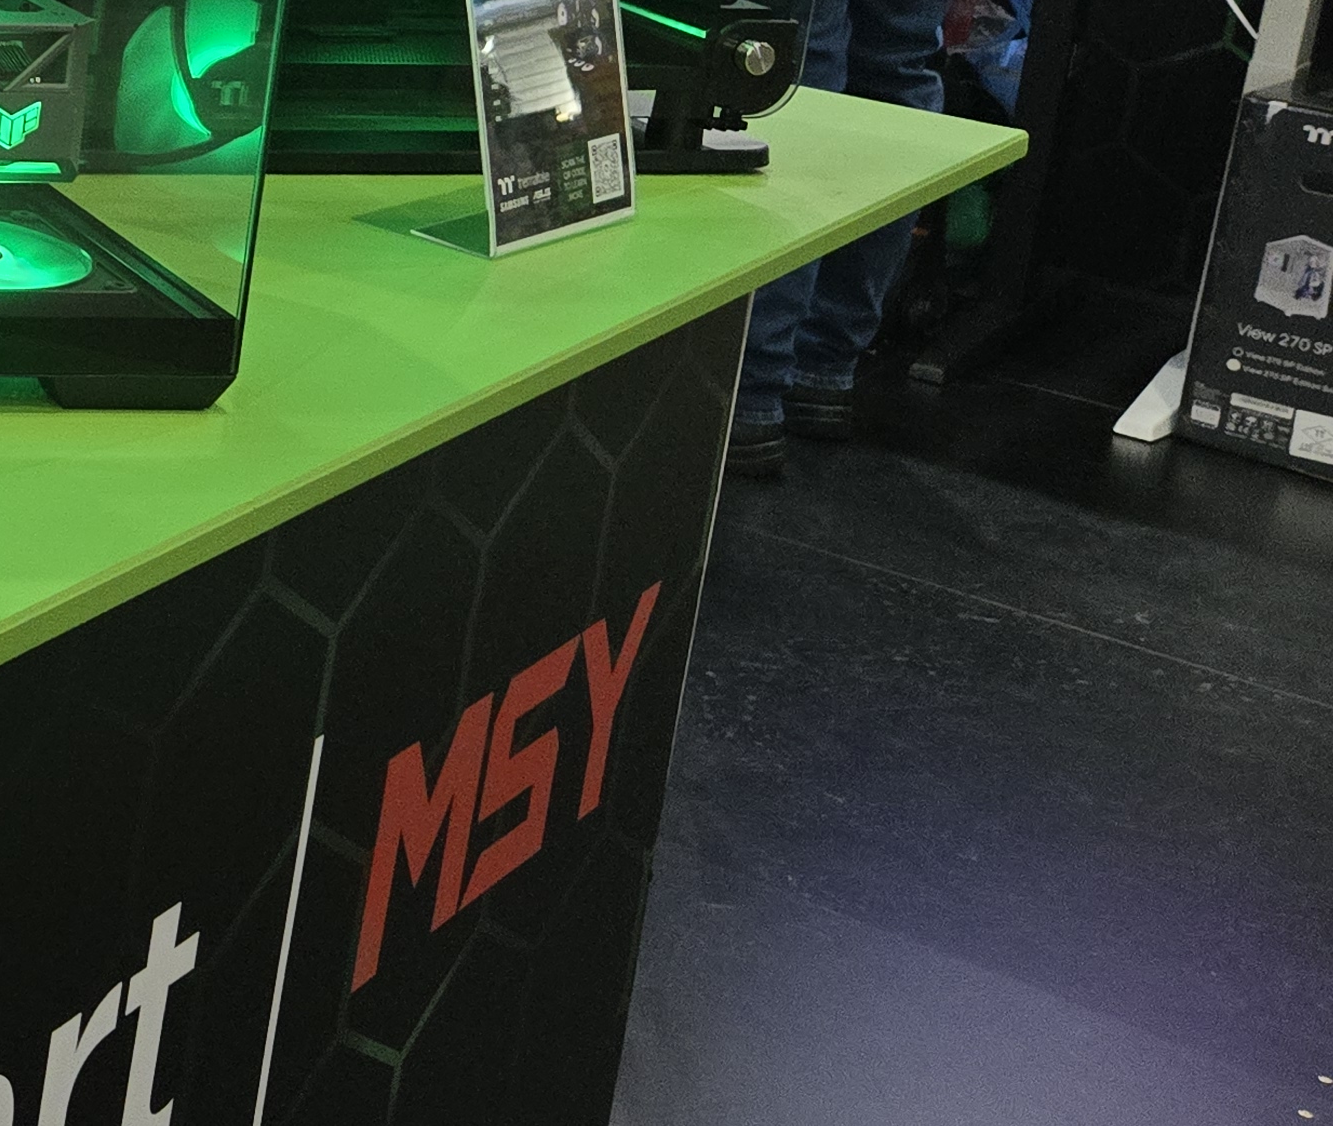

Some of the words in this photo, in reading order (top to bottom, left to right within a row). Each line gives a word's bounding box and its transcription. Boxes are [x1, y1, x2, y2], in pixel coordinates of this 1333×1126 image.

[1237, 322, 1276, 343] View
[1278, 333, 1311, 352] 270
[350, 580, 663, 994] MSY
